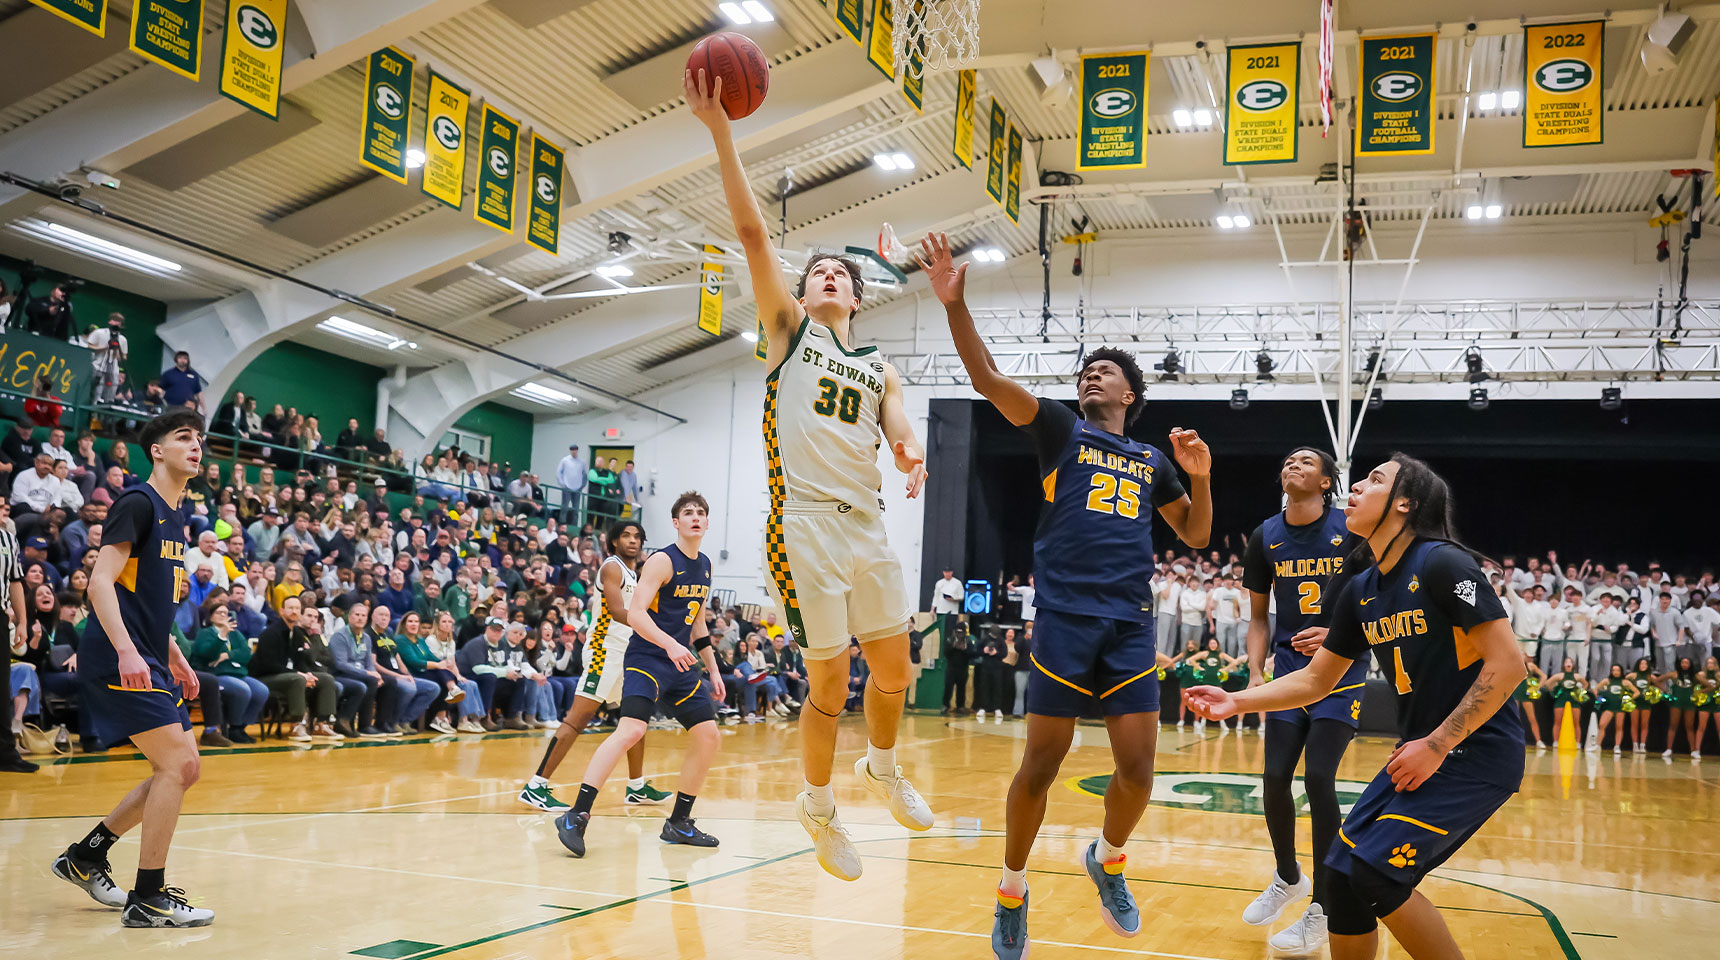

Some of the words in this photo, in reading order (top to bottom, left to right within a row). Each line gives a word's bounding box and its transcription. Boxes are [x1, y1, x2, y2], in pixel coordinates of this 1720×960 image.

[1543, 34, 1585, 48] 2022
[1247, 56, 1280, 69] 2021
[1380, 46, 1415, 60] 2021
[380, 54, 403, 76] 2017
[1098, 64, 1130, 78] 2021
[1542, 63, 1586, 89] E
[1242, 83, 1282, 109] E
[1377, 74, 1416, 99] E
[440, 91, 459, 111] 2017
[1095, 91, 1131, 115] E
[1540, 102, 1580, 110] DIVISION
[1373, 111, 1412, 120] DIVISION
[1382, 119, 1409, 127] STATE
[1534, 111, 1560, 119] STATE
[1563, 109, 1593, 118] DUALS
[1537, 117, 1590, 127] WRESTLING
[1369, 134, 1421, 144] CHAMPIONS
[1373, 127, 1418, 136] FOOTBALL
[1536, 126, 1590, 135] CHAMPIONS
[803, 347, 822, 368] ST.
[813, 376, 862, 425] 30
[1078, 445, 1154, 485] WILDCATS
[1086, 472, 1141, 519] 25
[1274, 556, 1344, 577] WILDCATS
[1298, 581, 1322, 614] 2
[684, 601, 701, 625] 3
[1393, 646, 1413, 695] 1
